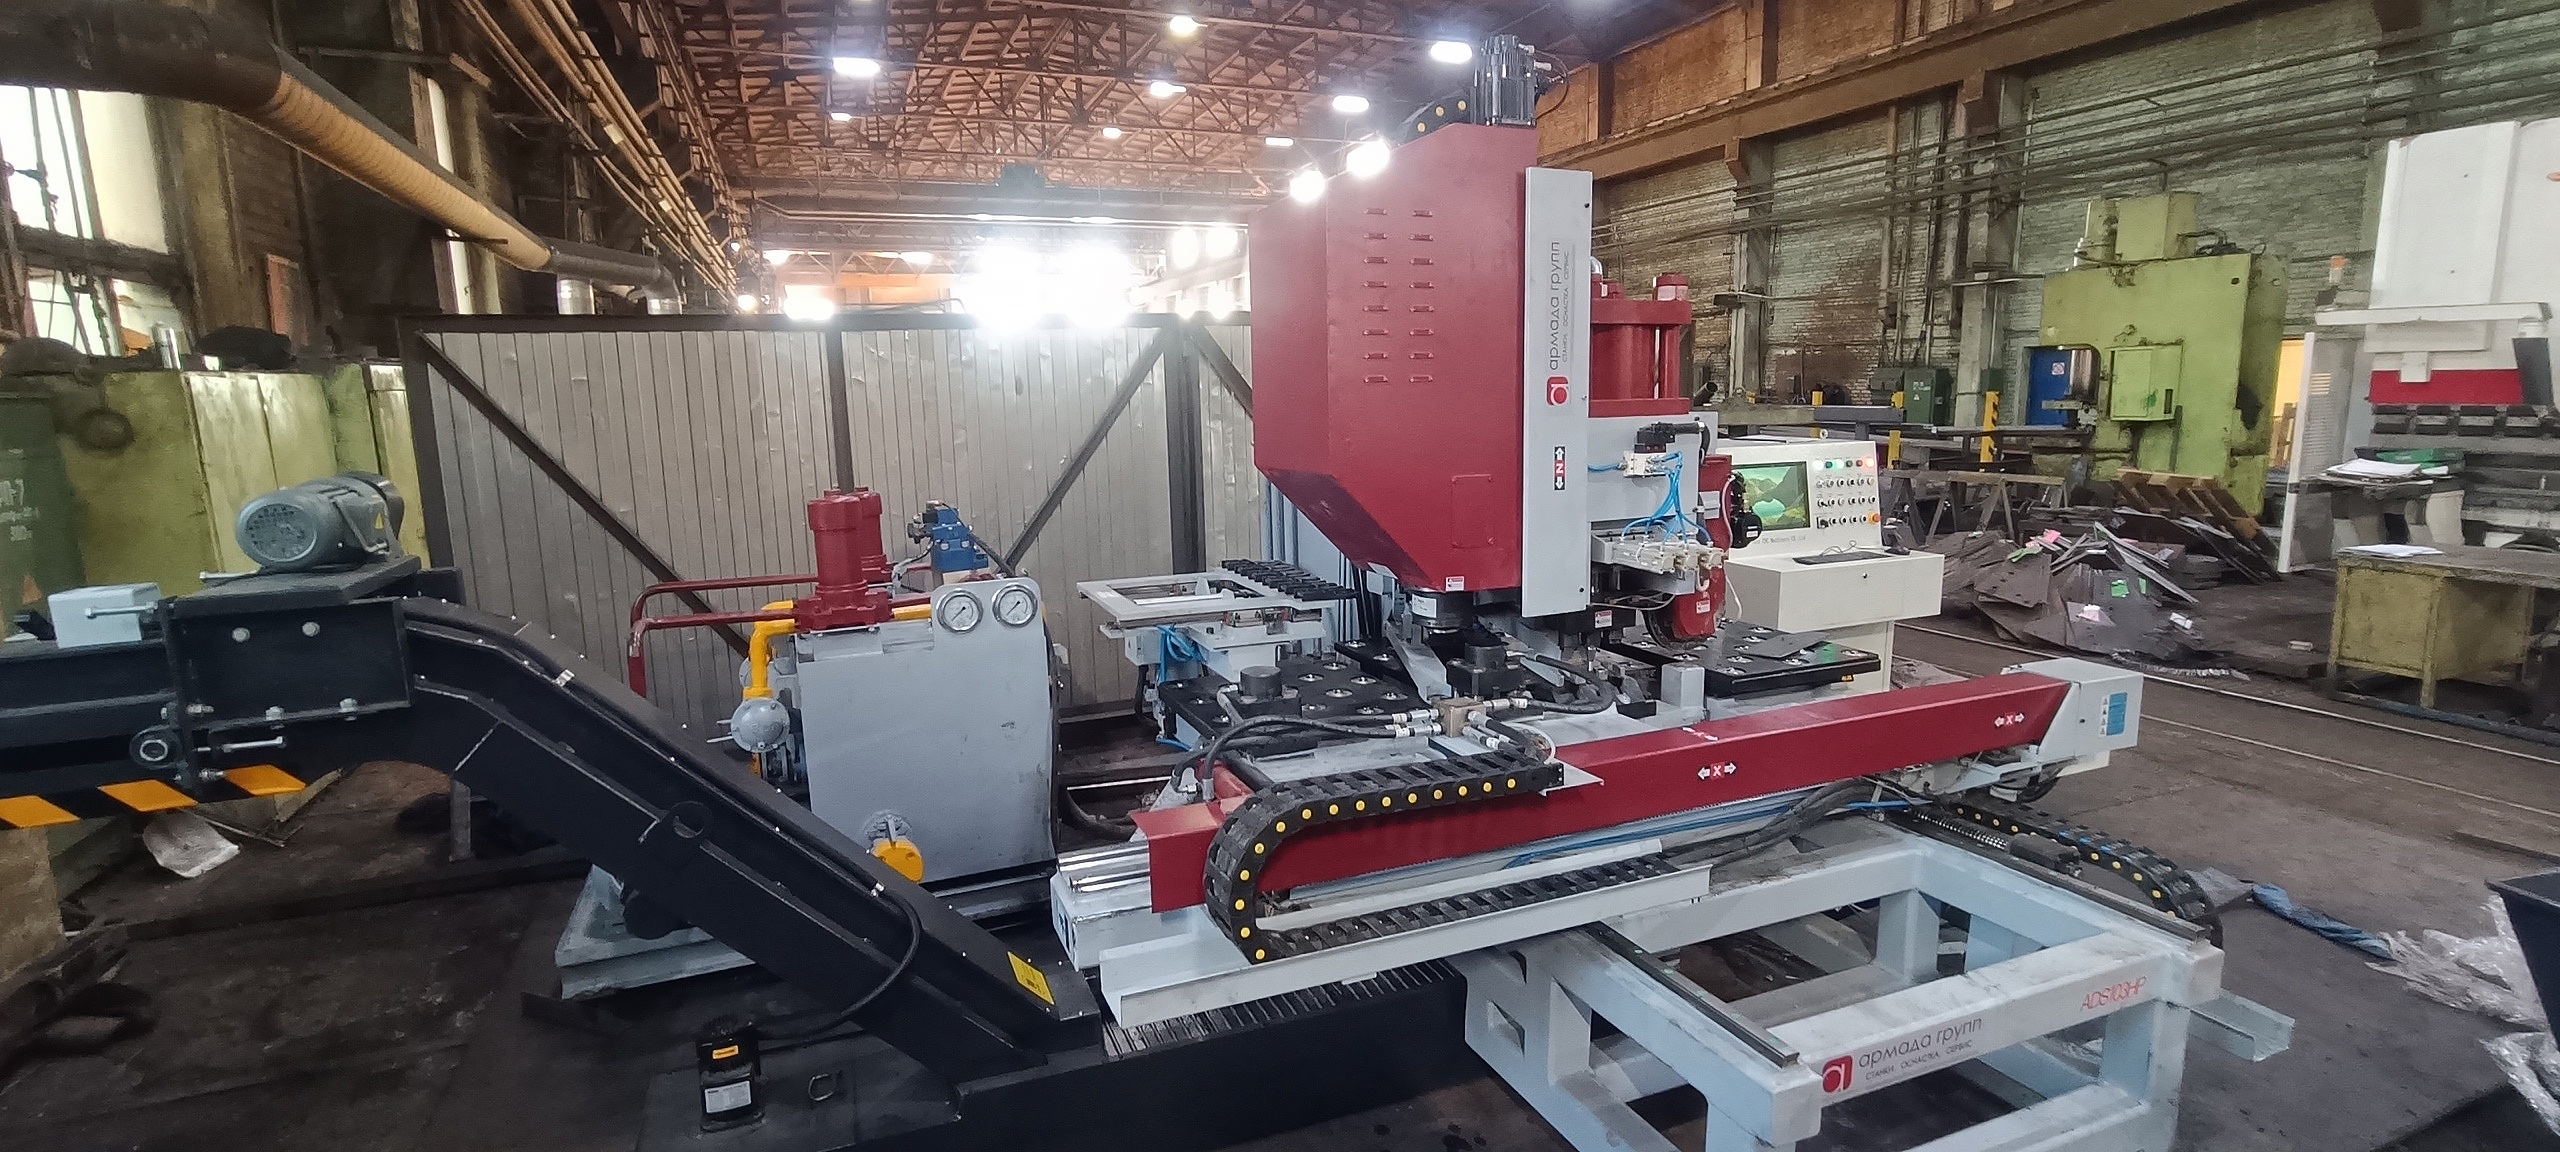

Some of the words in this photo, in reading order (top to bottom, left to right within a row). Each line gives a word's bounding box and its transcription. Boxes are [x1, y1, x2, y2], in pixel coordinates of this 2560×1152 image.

[1551, 242, 1562, 291] групп
[1549, 296, 1561, 371] армада
[1713, 764, 1721, 777] X
[1858, 1034, 1932, 1068] армада
[1936, 1017, 1982, 1045] групп
